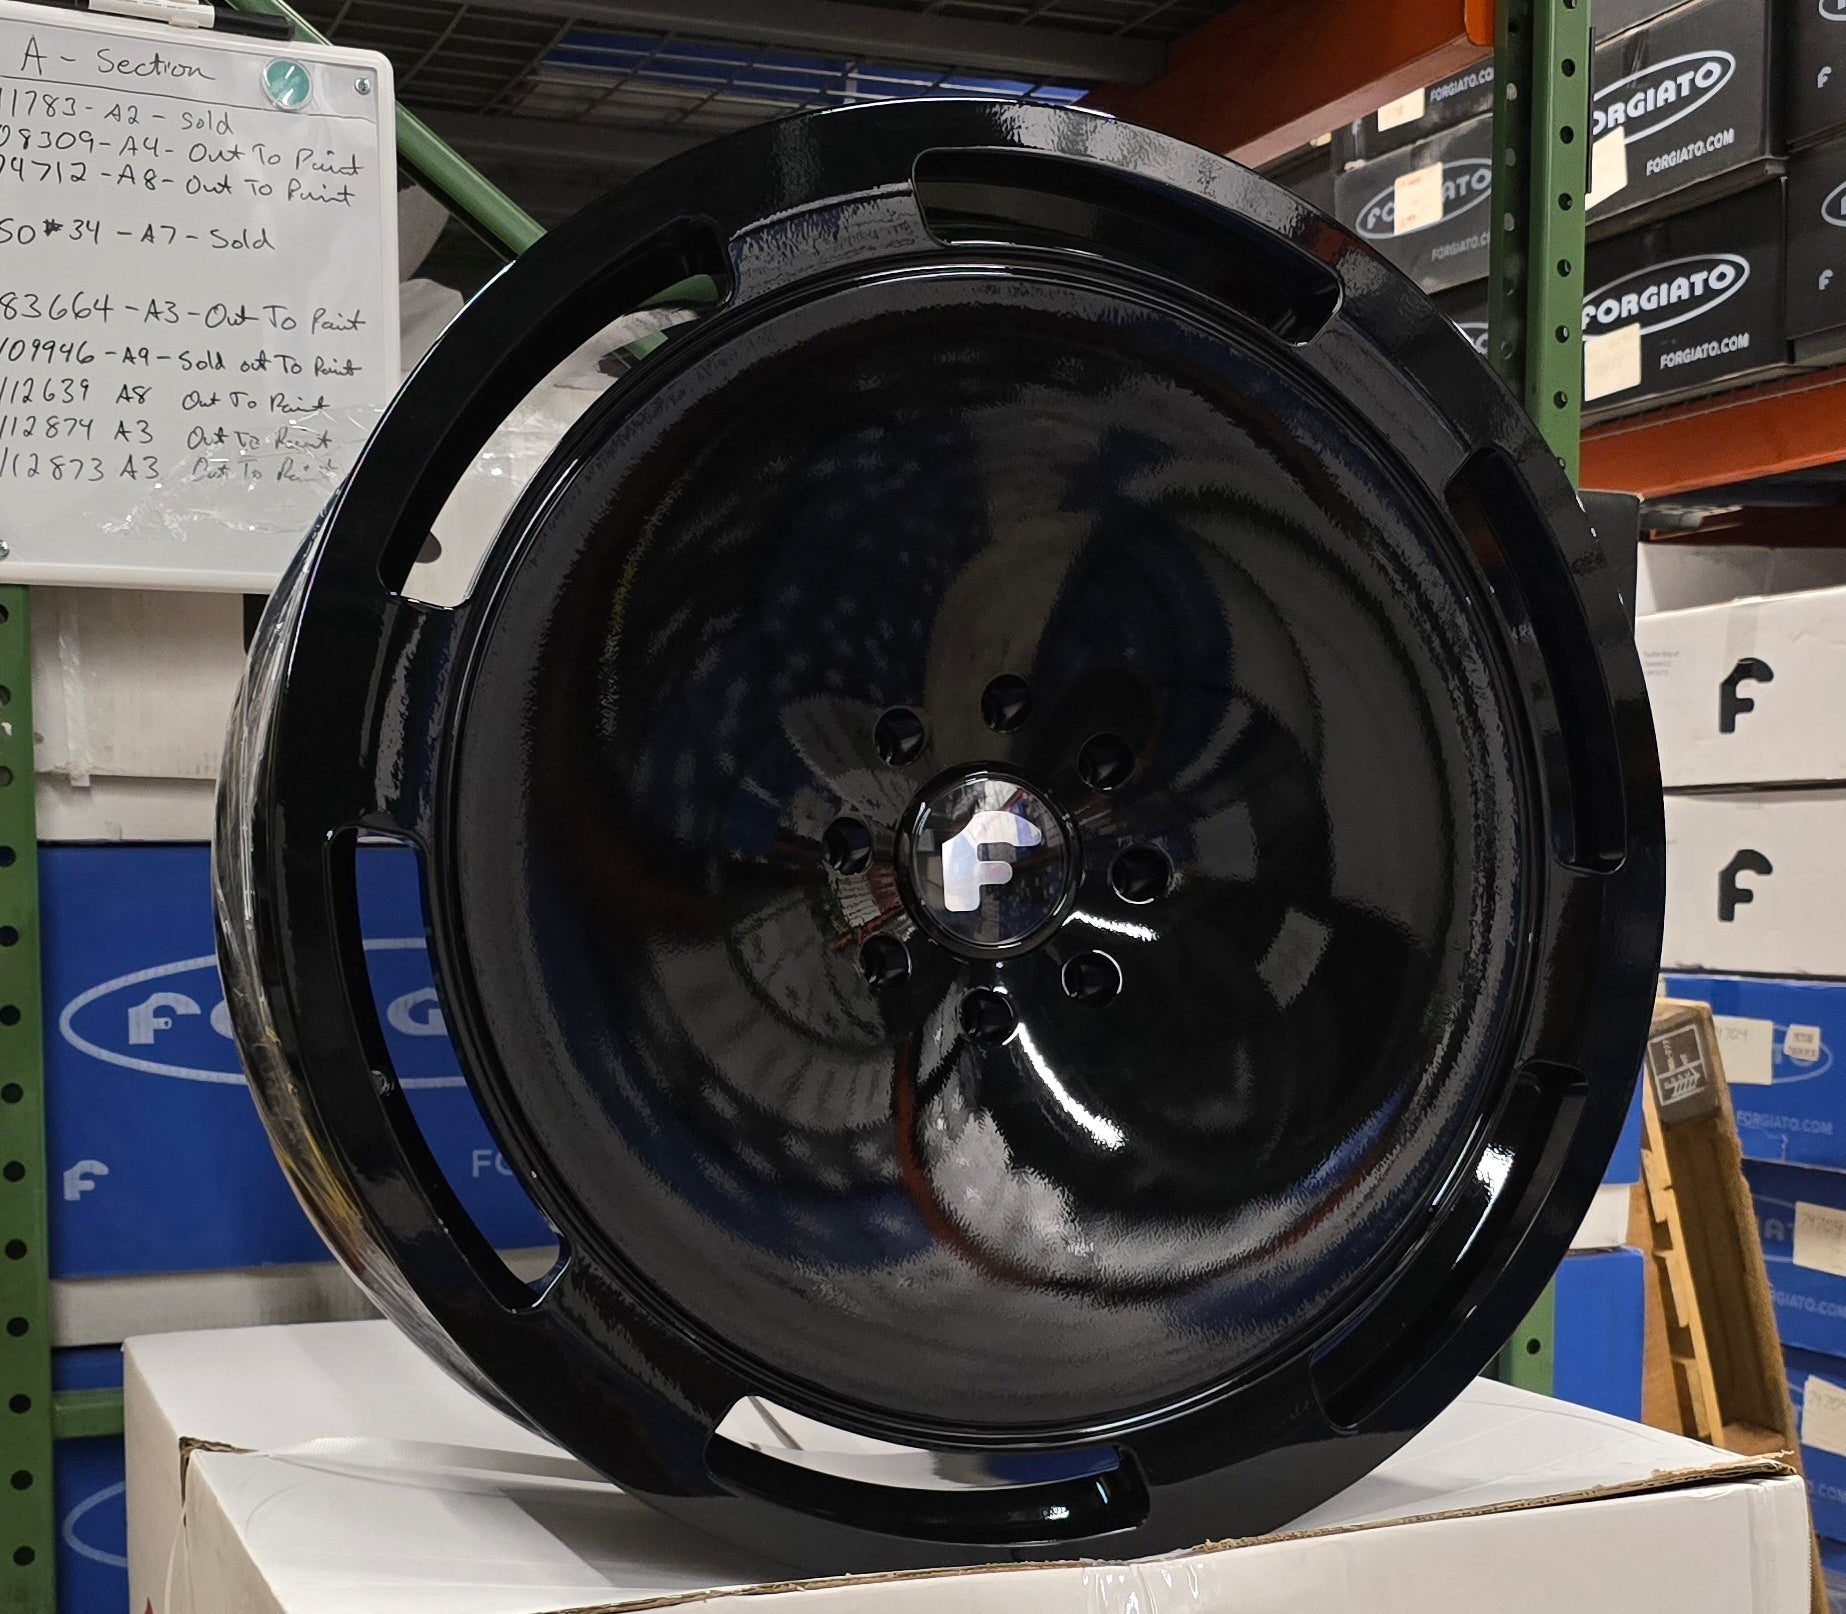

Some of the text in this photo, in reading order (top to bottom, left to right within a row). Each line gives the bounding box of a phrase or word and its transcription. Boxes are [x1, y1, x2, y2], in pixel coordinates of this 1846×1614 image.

[20, 33, 48, 75] A
[96, 48, 216, 81] Section
[1429, 66, 1495, 103] FORGIATO.CO
[1592, 61, 1723, 136] ORGIATO
[188, 143, 246, 163] Out
[252, 143, 281, 165] To
[295, 148, 364, 176] Paint
[1646, 127, 1736, 177] FORGIATO.COM
[185, 175, 232, 195] Out
[244, 179, 273, 196] To
[1366, 168, 1493, 230] FOATO
[210, 228, 276, 250] Sold
[0, 291, 114, 323] 83664
[205, 303, 259, 328] Out
[262, 305, 297, 330] To
[311, 307, 366, 335] Paint
[1581, 263, 1736, 331] FORGIATO
[178, 350, 226, 371] Sold
[273, 354, 302, 374] To
[314, 355, 362, 377] Paint
[1660, 332, 1750, 370] FORGIATO.COM
[115, 384, 152, 404] A8
[182, 390, 220, 411] Out
[229, 391, 257, 409] To
[0, 415, 94, 441] 112874
[114, 420, 153, 444] A3
[187, 426, 229, 450] Out
[0, 446, 104, 482] 112873
[119, 453, 159, 481] A3
